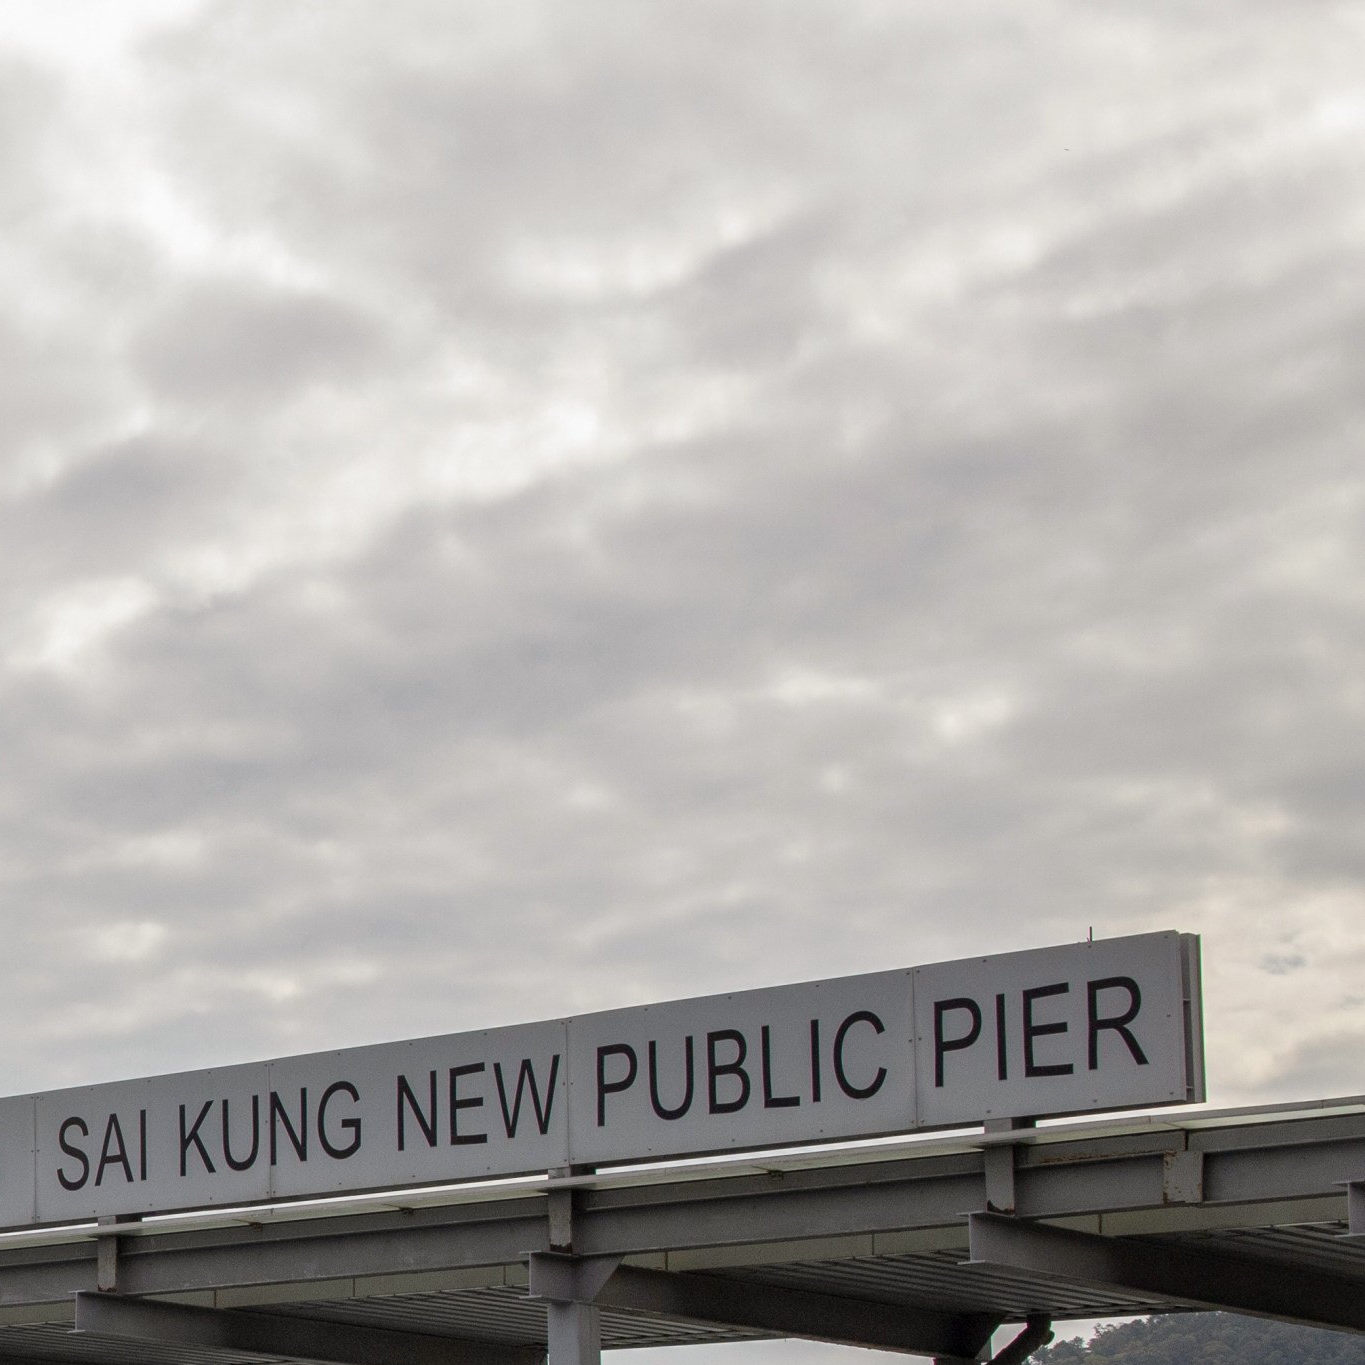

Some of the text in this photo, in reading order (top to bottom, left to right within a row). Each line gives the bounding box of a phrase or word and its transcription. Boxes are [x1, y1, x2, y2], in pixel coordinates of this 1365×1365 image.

[55, 974, 1151, 1191] SAI KUNG NEW PUBLIC PIER
